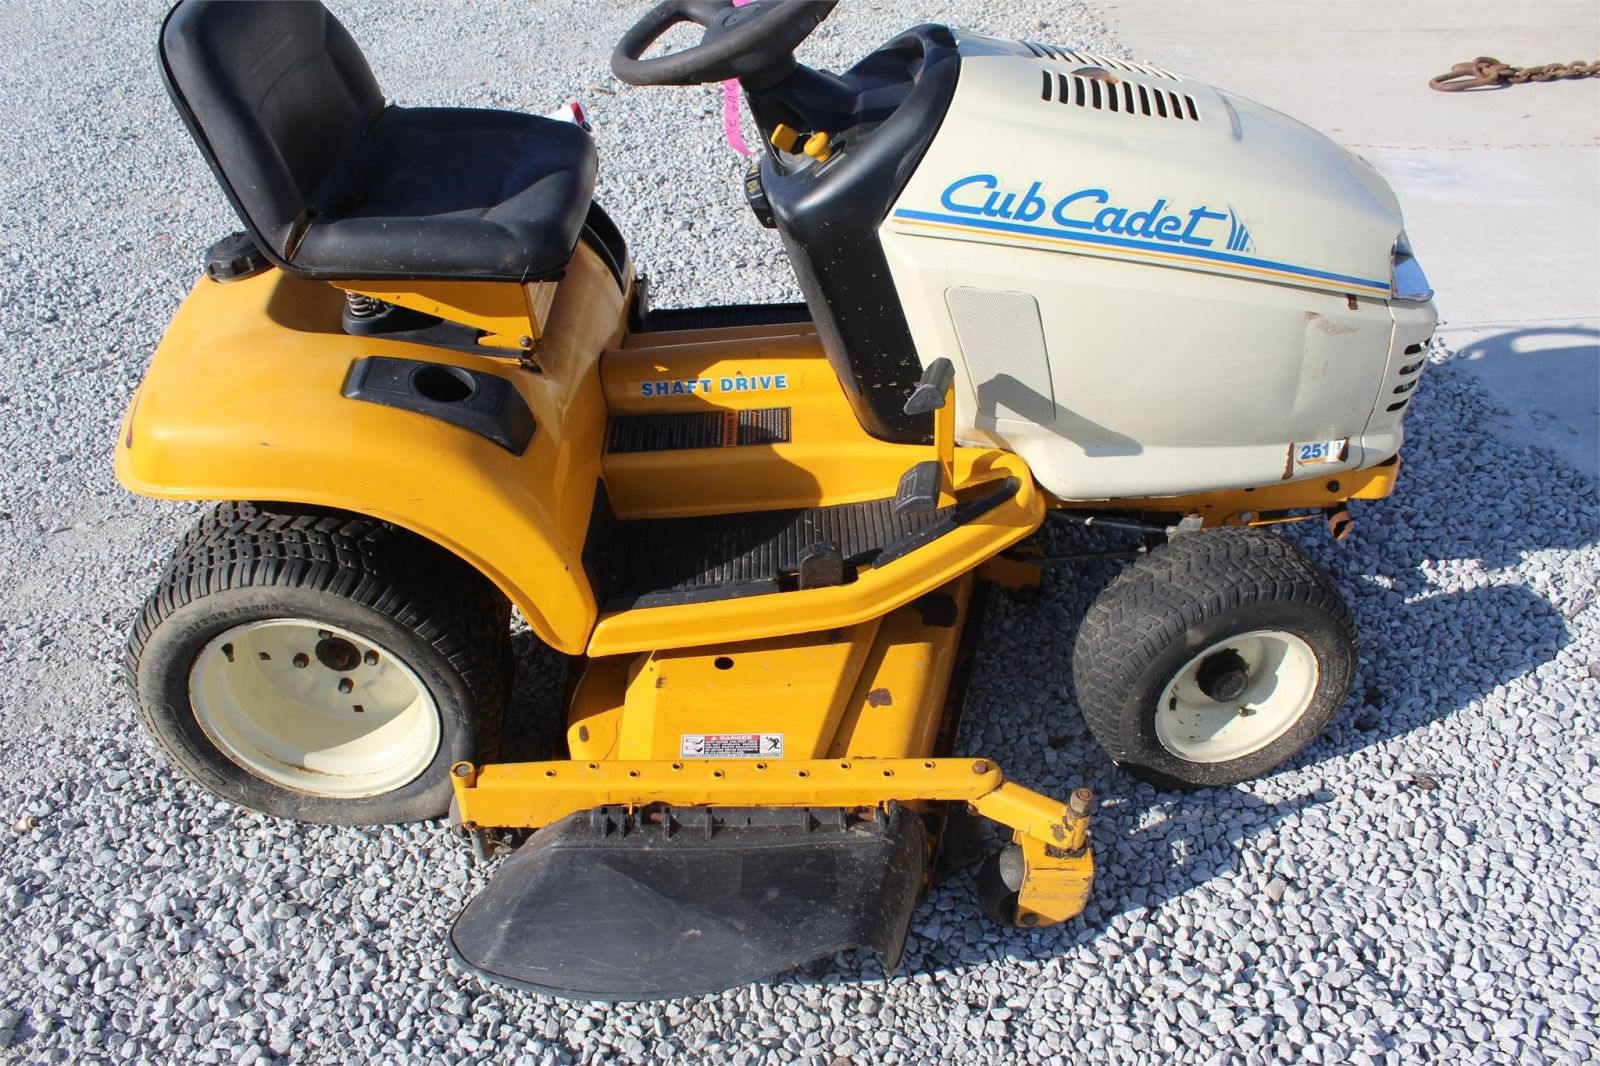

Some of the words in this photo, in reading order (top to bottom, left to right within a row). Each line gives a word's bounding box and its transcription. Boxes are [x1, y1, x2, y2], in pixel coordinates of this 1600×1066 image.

[941, 174, 1046, 222] Cub
[1052, 189, 1228, 246] Cadet
[641, 379, 711, 397] SHAFT
[720, 375, 787, 392] DRIVE
